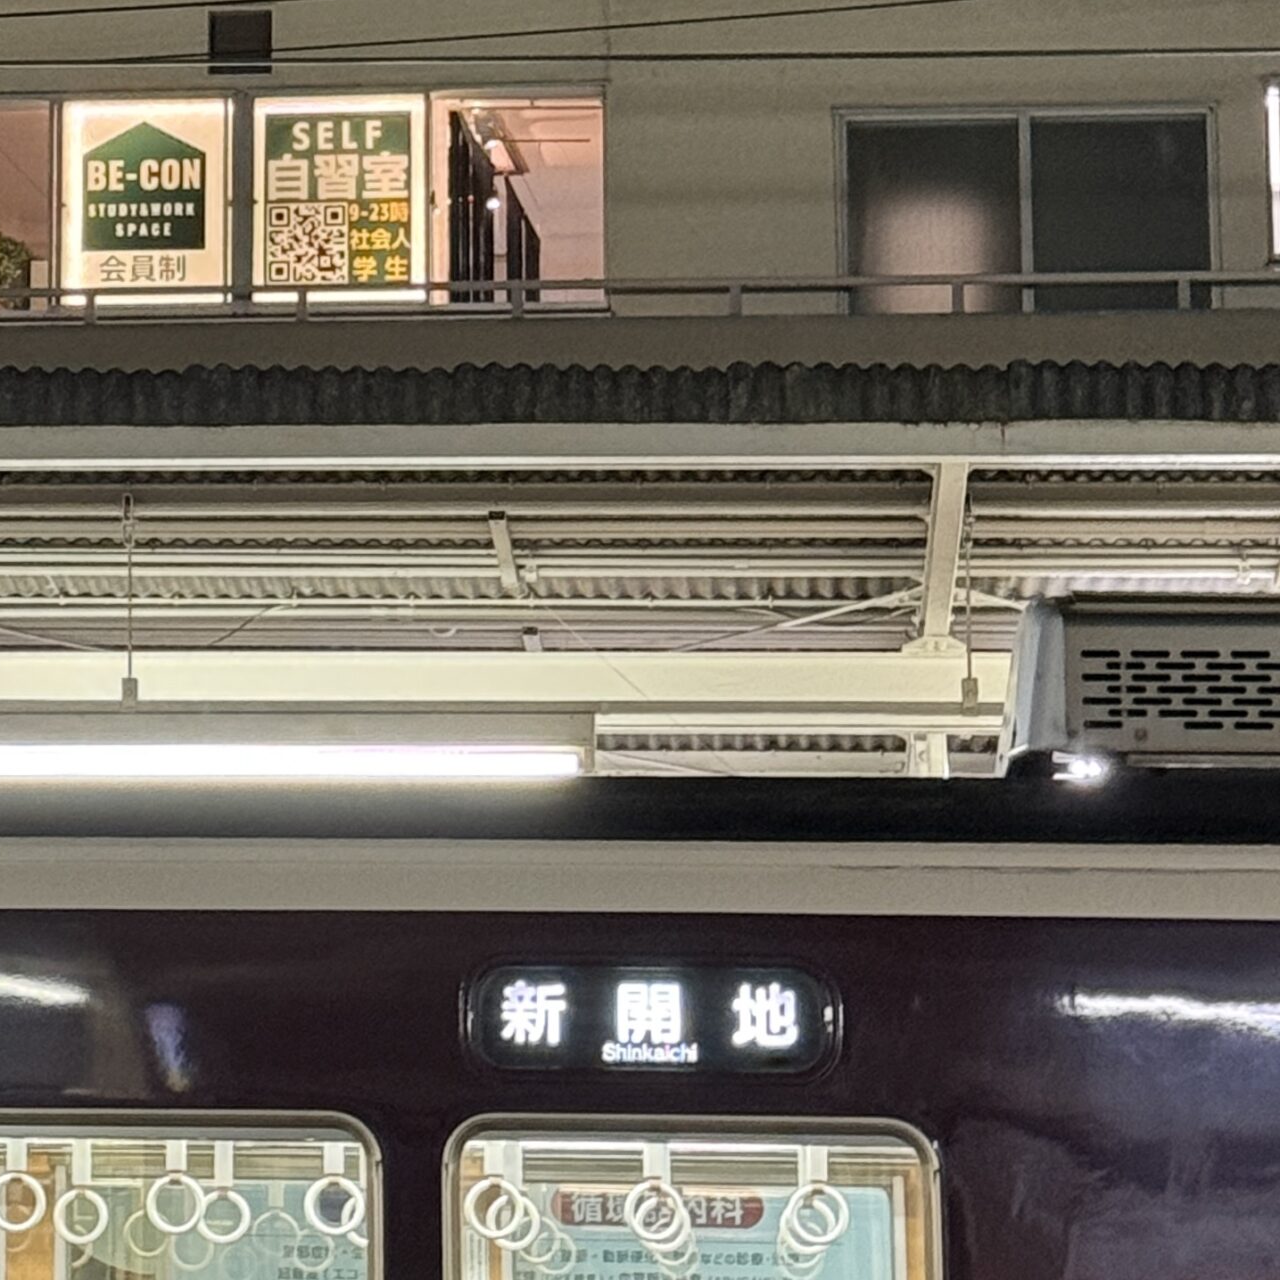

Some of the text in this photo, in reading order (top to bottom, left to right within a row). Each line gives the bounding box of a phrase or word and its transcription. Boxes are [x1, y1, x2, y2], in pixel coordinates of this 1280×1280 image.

[291, 120, 383, 151] SELF
[86, 158, 202, 192] BE-CON
[267, 151, 410, 201] 自習室
[348, 202, 409, 223] 9-23時
[114, 222, 172, 238] SPACE
[349, 227, 411, 251] 社会人
[99, 254, 187, 283] 会員制
[351, 254, 409, 283] 学生
[499, 980, 800, 1048] 新開地
[601, 1041, 699, 1064] Shinkaichi
